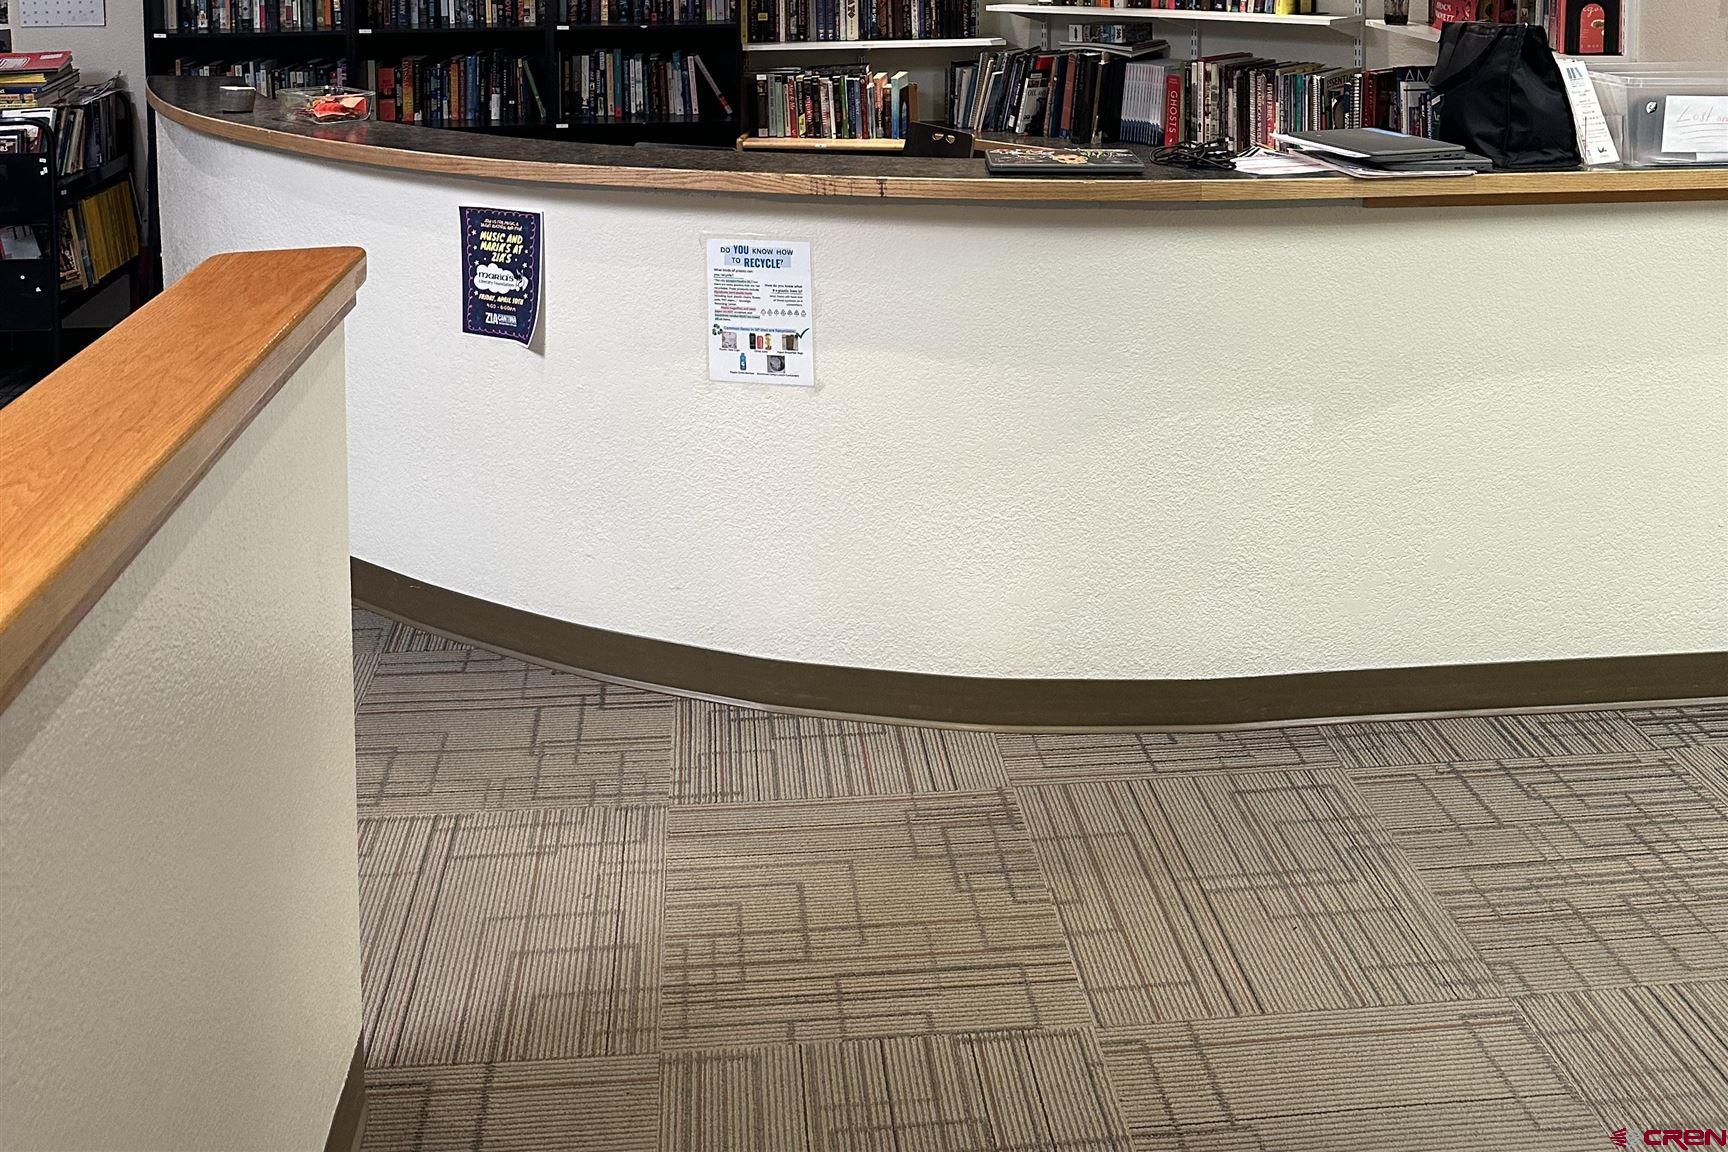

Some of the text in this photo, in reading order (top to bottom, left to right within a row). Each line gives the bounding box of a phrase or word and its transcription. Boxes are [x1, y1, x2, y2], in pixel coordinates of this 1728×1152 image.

[1169, 90, 1178, 133] GHOSTS
[1676, 105, 1713, 122] Lost
[480, 231, 523, 244] MUSIC AND
[480, 241, 523, 255] MARIA'S AT
[733, 245, 749, 254] YOU
[491, 252, 512, 263] ZIA'S
[744, 258, 784, 269] RECYCLE?
[497, 295, 511, 303] APRIL
[485, 312, 517, 325] ZIA CANTINA
